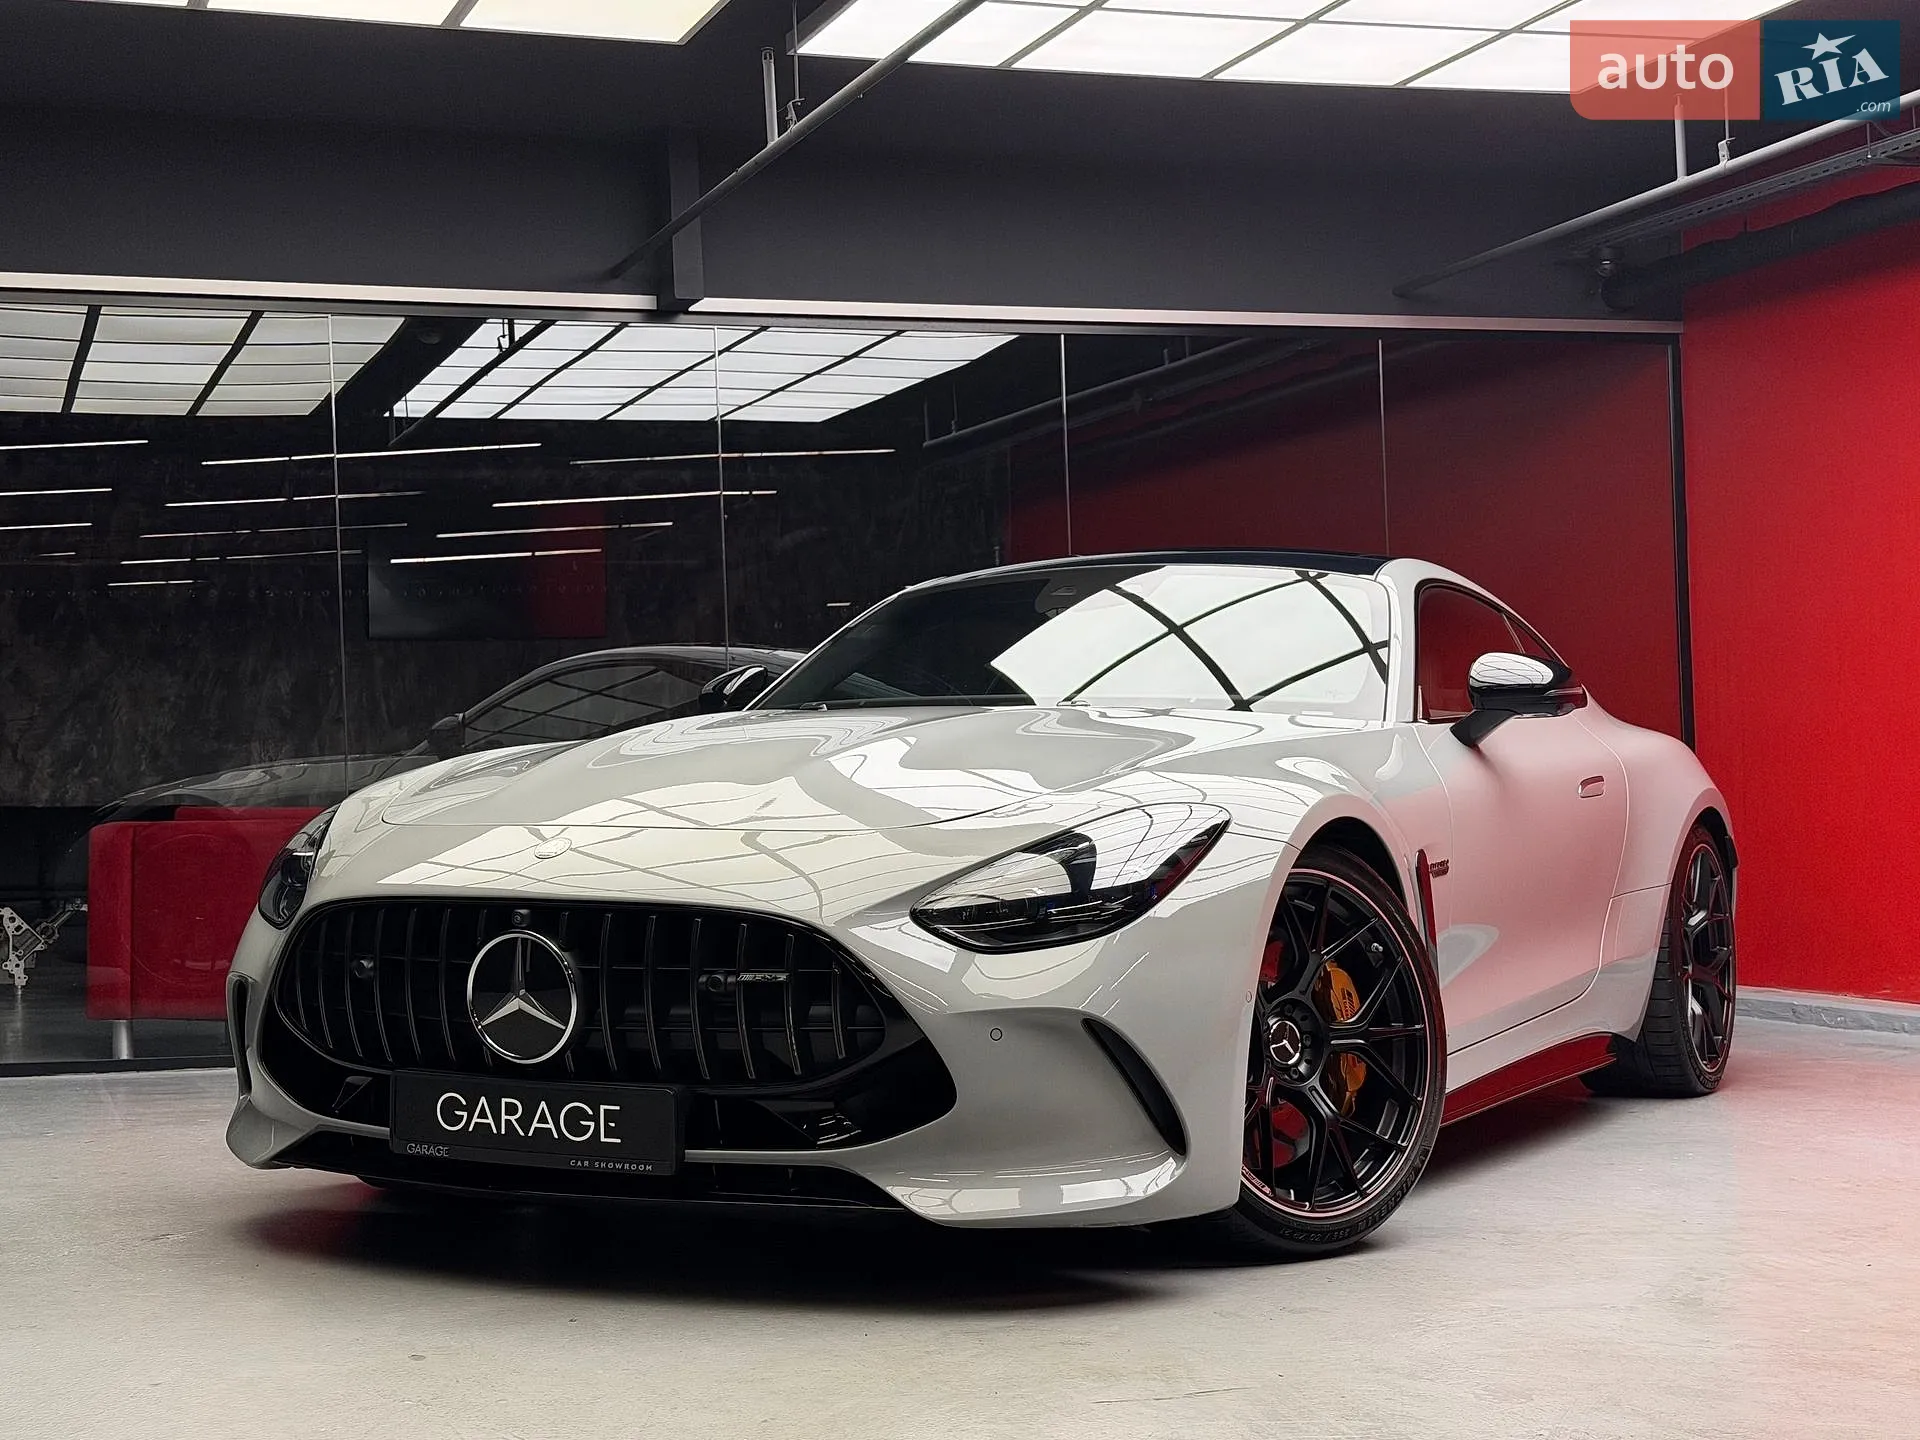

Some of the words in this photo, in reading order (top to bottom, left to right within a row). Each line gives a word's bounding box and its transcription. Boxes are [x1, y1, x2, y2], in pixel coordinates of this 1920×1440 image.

[436, 1092, 621, 1143] GARAGE
[406, 1143, 449, 1156] GARAGE
[594, 1161, 653, 1171] SHOWROOM
